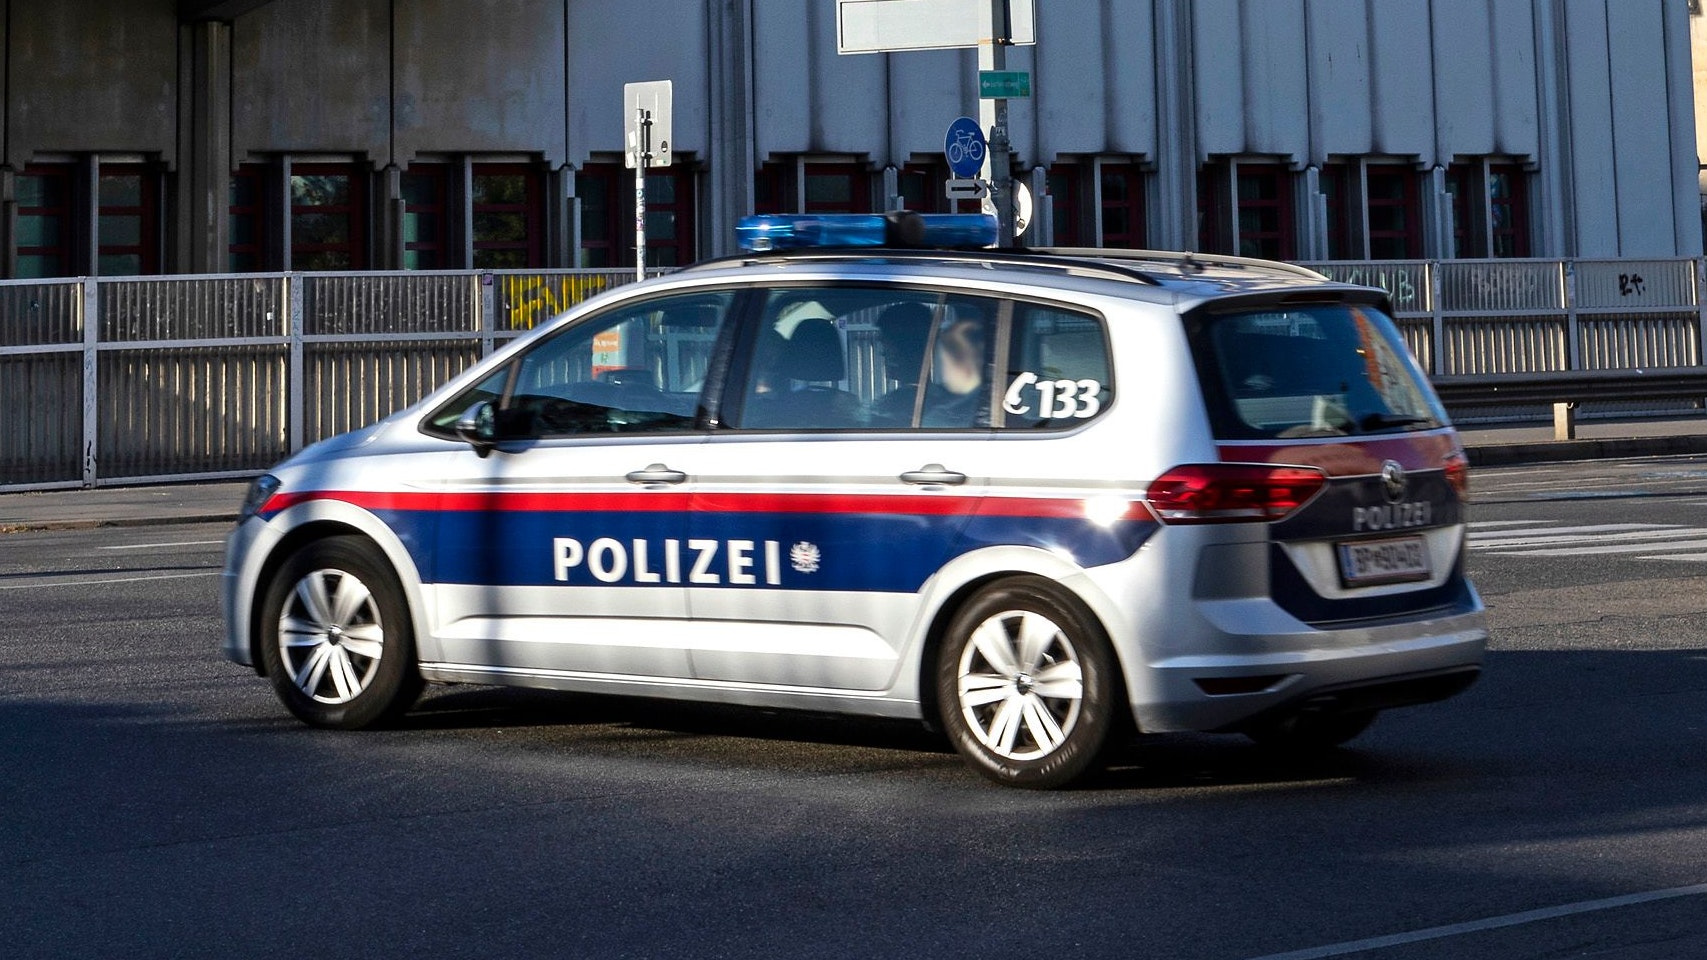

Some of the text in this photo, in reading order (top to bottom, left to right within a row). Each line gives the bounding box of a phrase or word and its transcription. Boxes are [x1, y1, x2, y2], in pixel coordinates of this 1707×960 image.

[1035, 379, 1101, 418] 133
[1353, 501, 1432, 531] POLIZEI
[553, 537, 781, 585] POLIZEI
